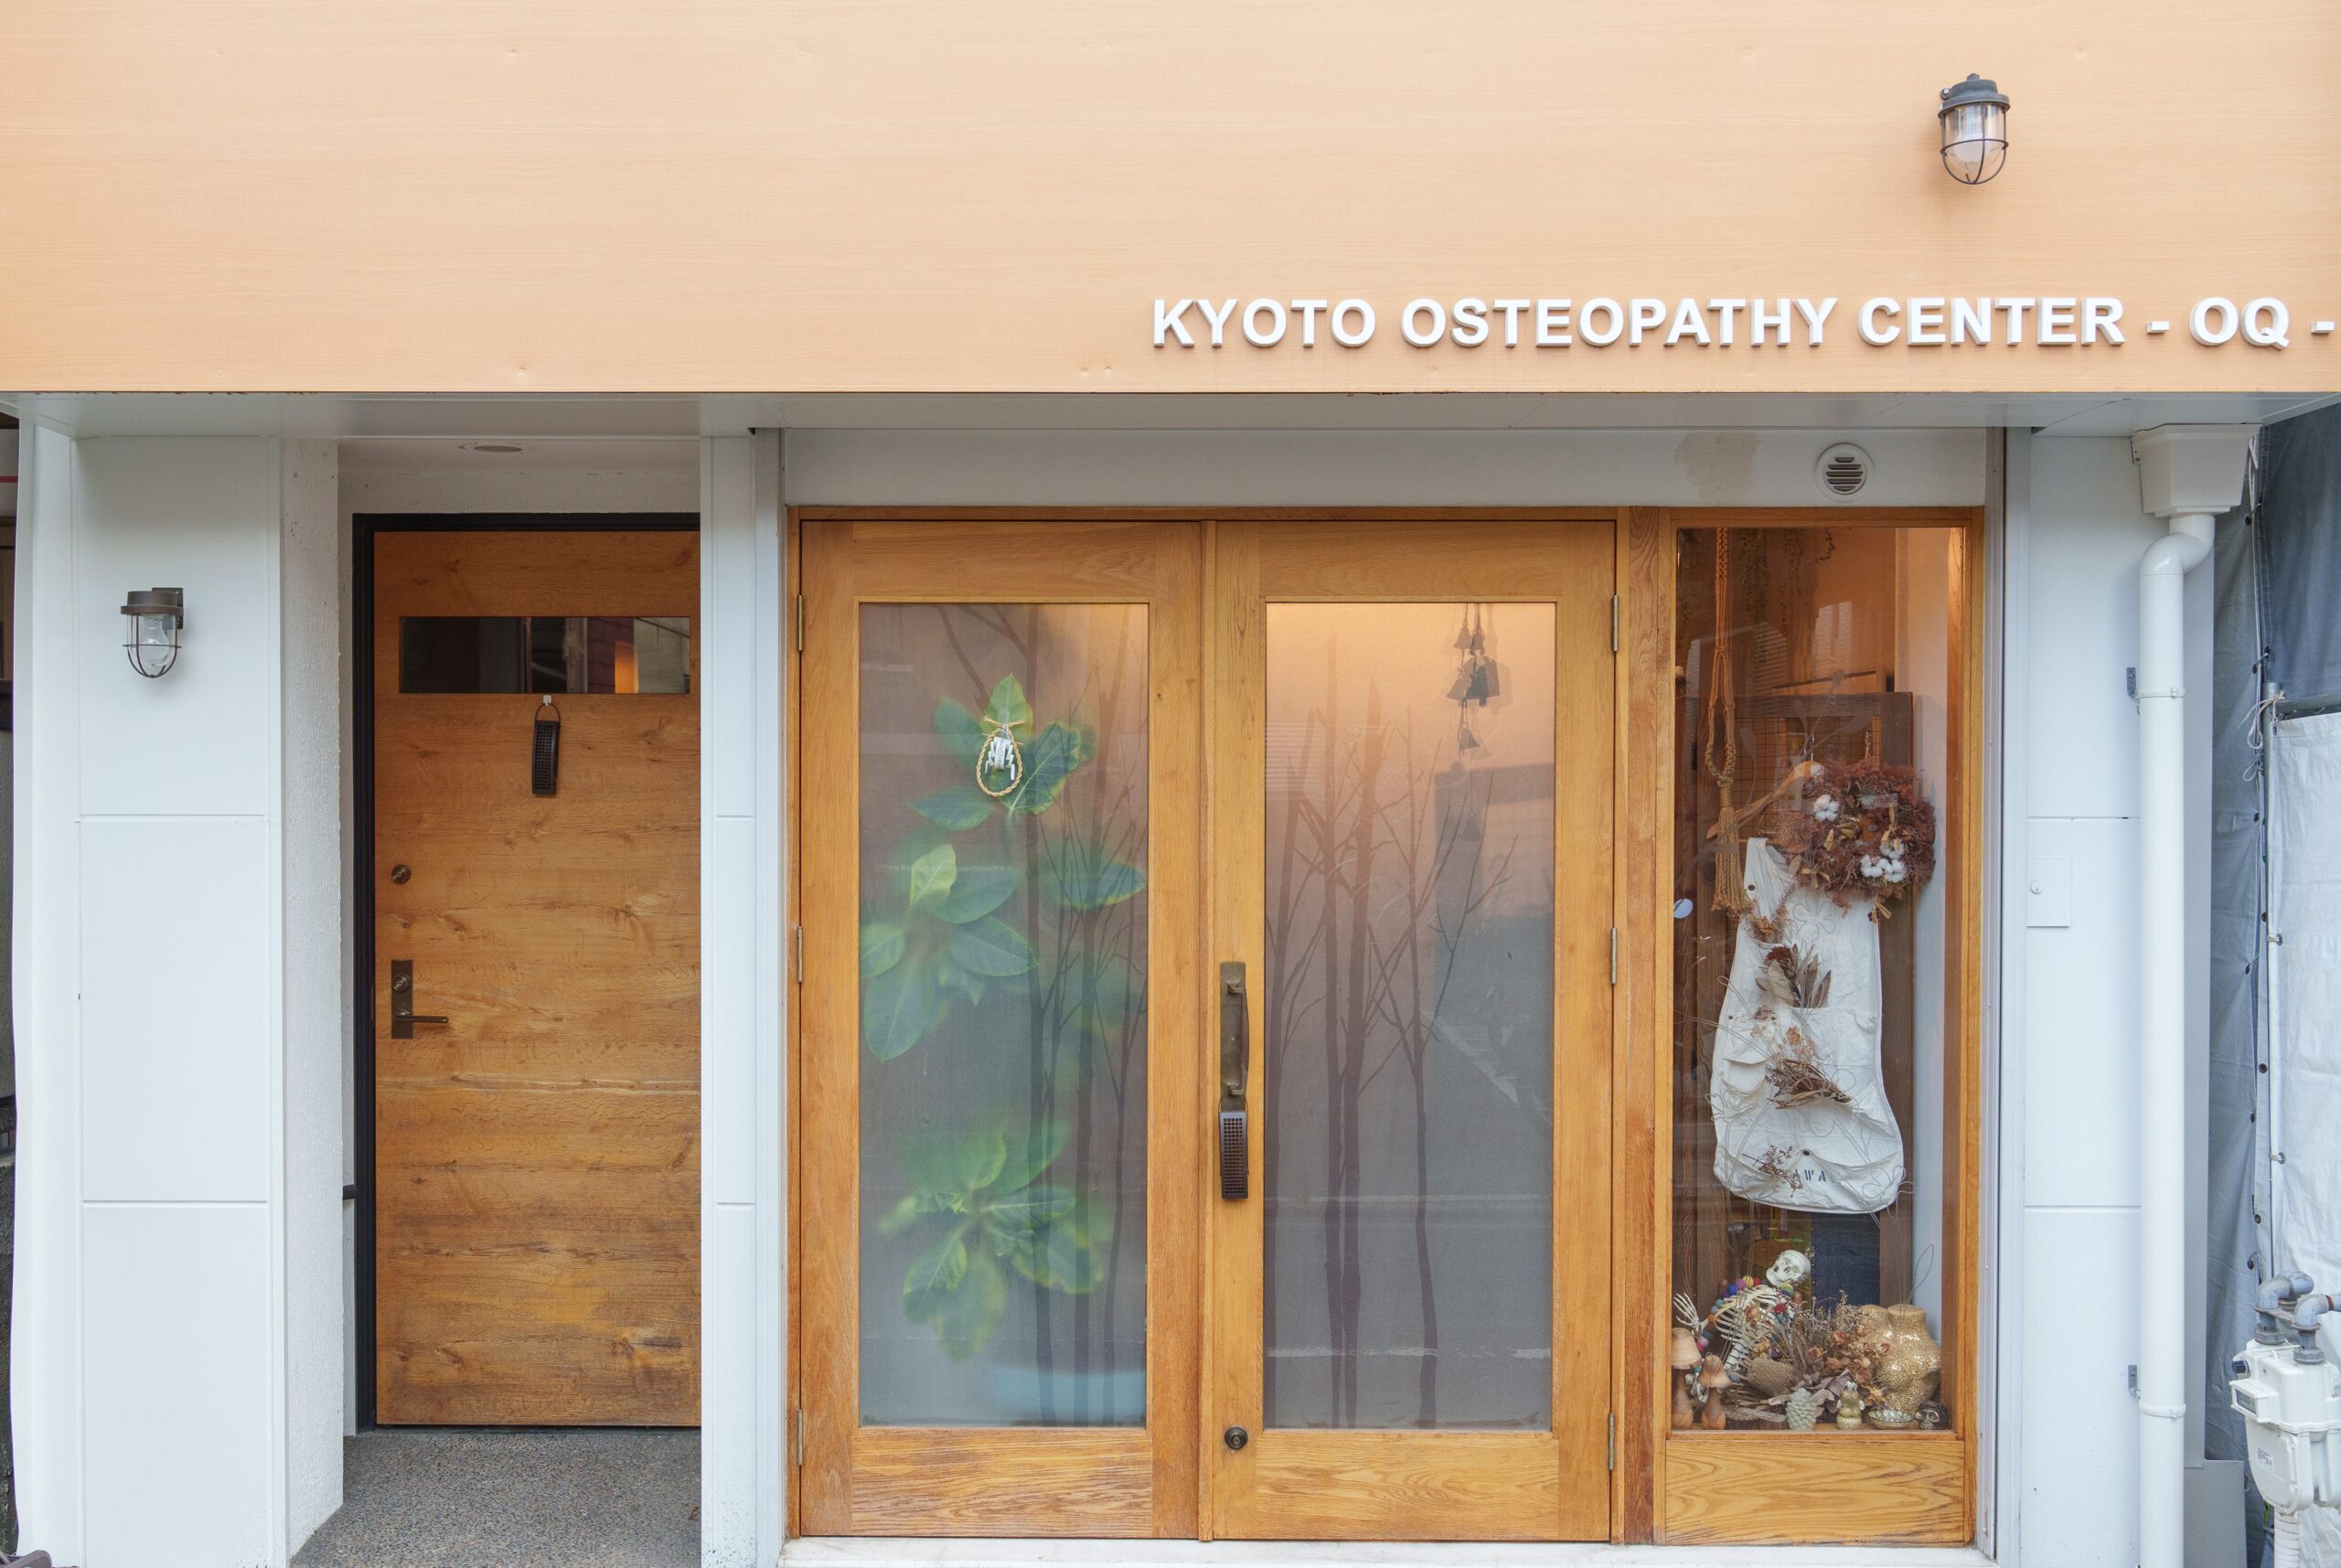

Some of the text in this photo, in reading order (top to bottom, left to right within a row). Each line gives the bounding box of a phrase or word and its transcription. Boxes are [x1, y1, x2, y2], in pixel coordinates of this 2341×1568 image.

[1153, 298, 1376, 347] KYOTO
[1401, 297, 1838, 347] OSTEOPATHY
[1858, 297, 2126, 347] CENTER
[2188, 296, 2290, 349] OQ
